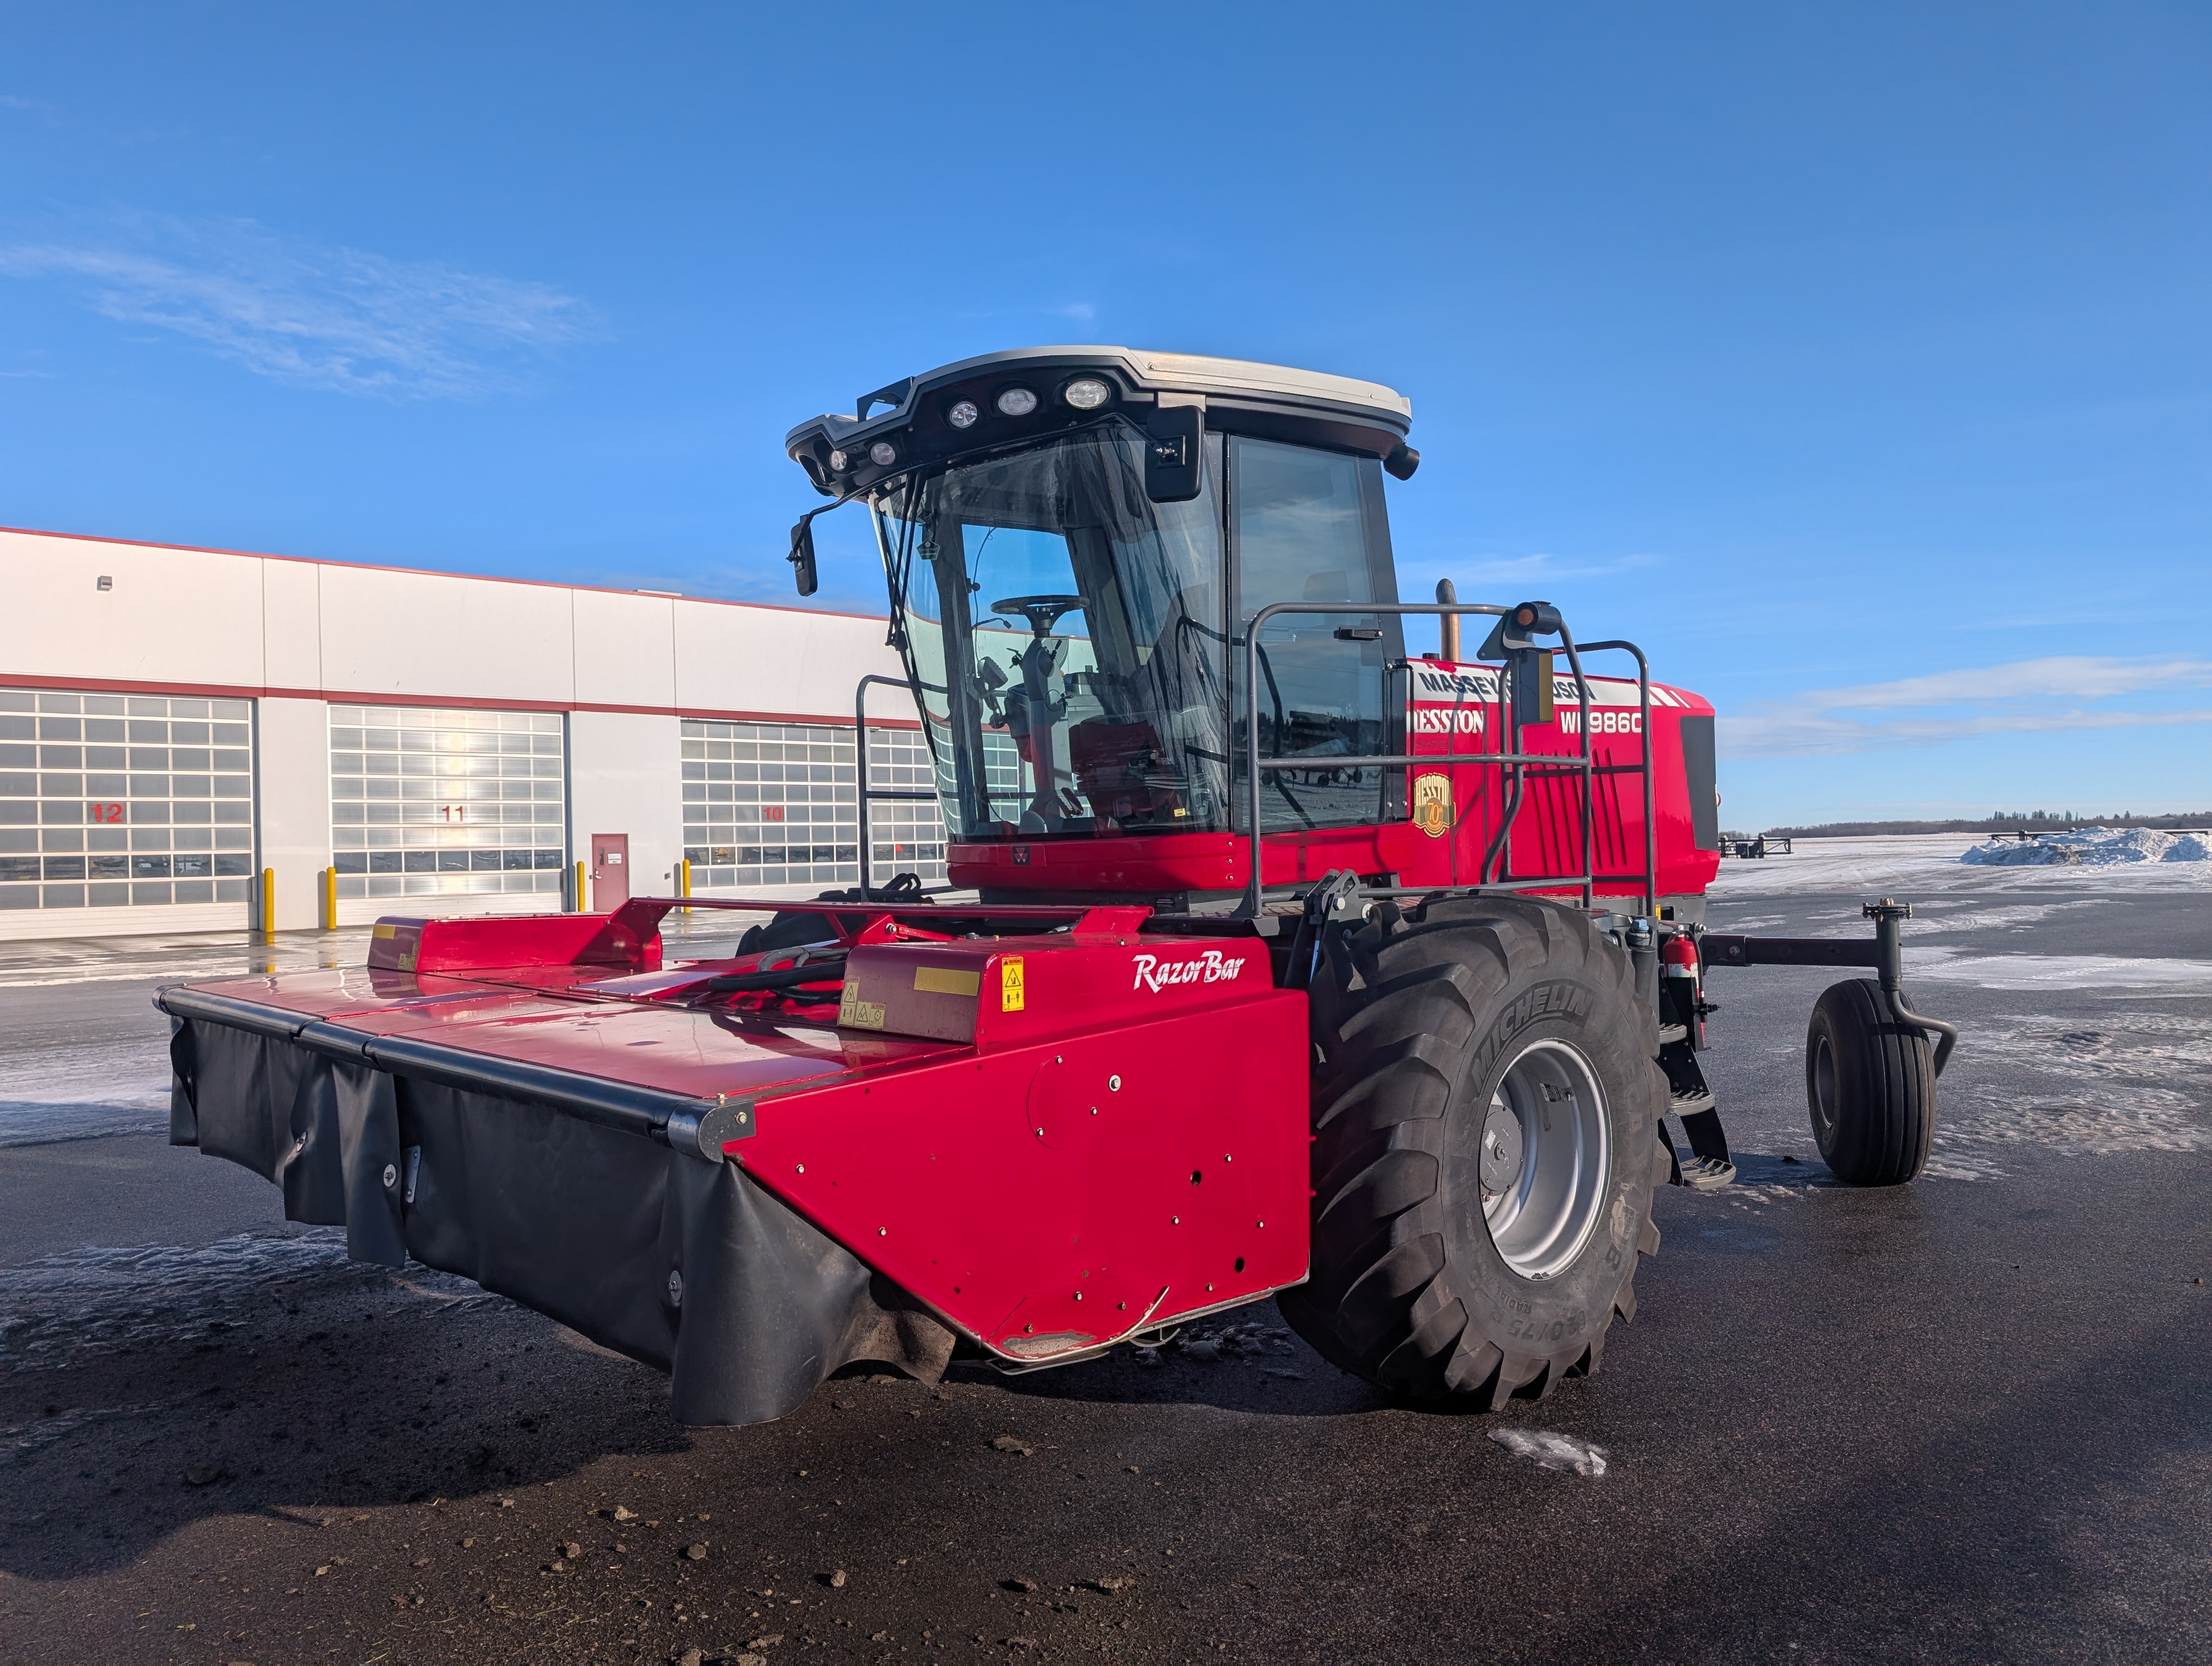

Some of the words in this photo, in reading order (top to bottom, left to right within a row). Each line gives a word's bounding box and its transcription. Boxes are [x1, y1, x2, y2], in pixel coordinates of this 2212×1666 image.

[1417, 672, 1499, 695] MASSEY
[1560, 712, 1642, 733] W9860
[1415, 775, 1452, 806] HESSTON
[91, 803, 123, 823] 12
[442, 805, 463, 821] 11
[763, 806, 783, 821] 10
[1471, 985, 1593, 1093] MICHELIN
